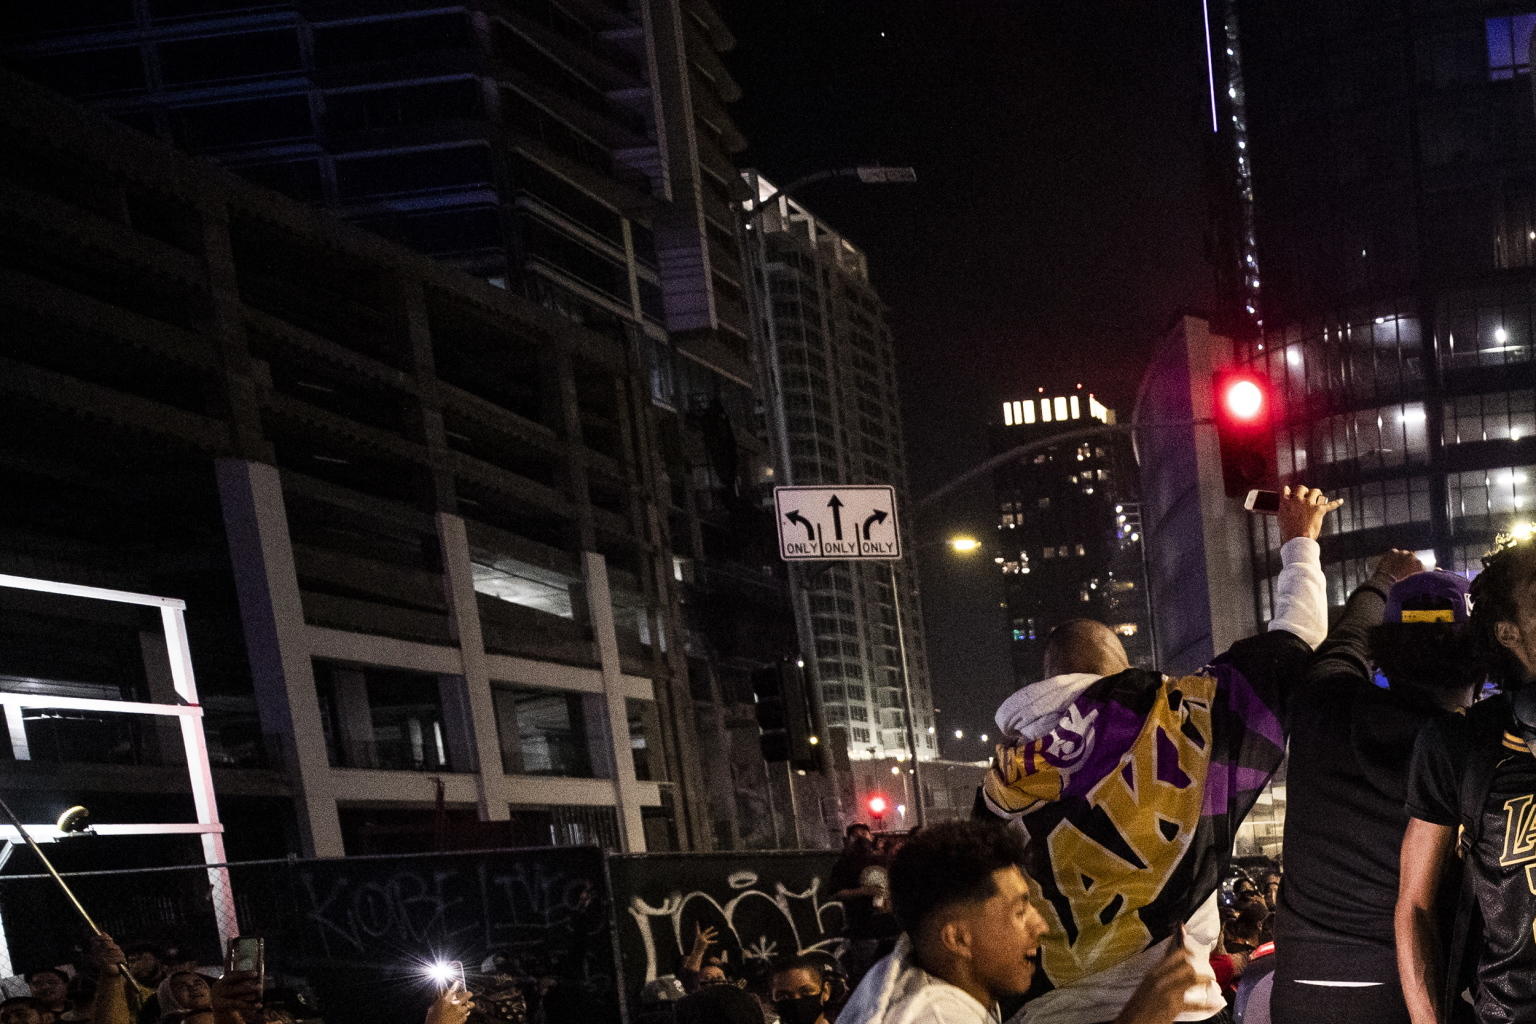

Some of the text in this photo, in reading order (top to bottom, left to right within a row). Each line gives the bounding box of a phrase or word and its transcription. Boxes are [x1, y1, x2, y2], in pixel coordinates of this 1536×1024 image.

[786, 541, 894, 555] ONLY ONLY ONLY
